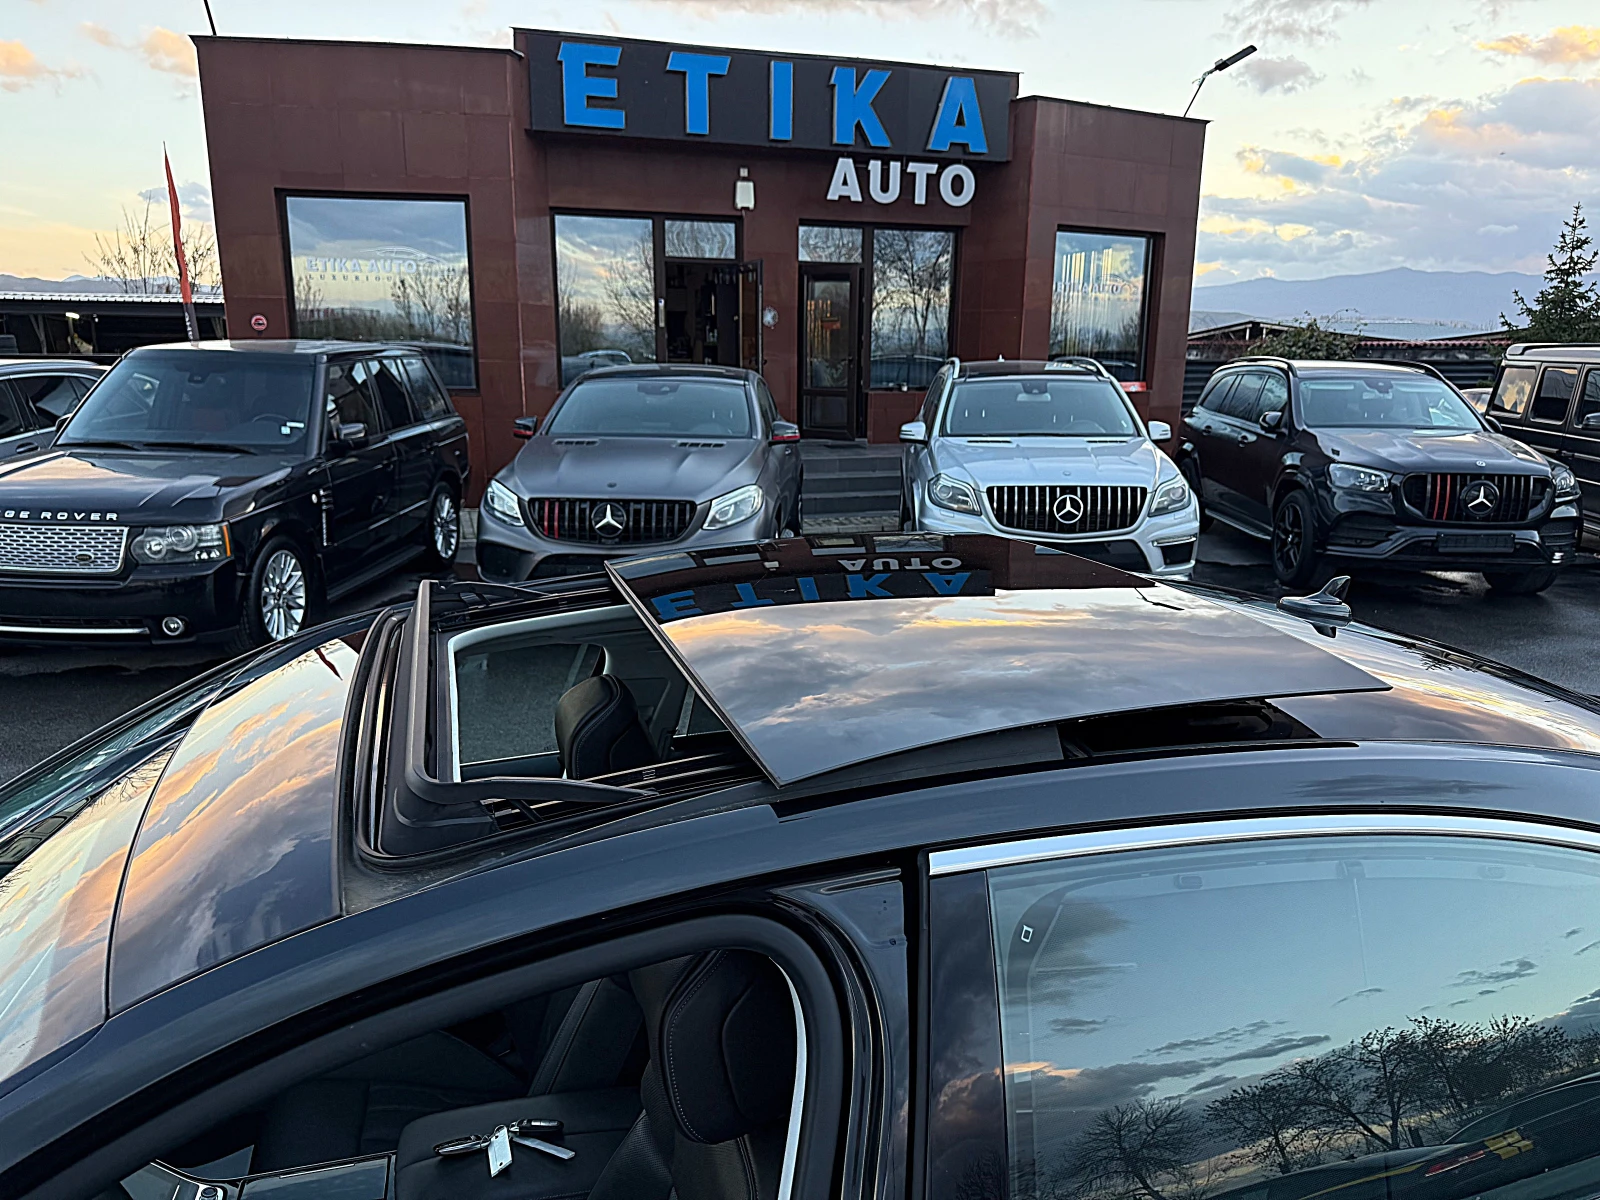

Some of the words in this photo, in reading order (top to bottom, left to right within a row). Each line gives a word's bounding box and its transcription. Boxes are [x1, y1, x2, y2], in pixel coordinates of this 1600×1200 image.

[557, 41, 989, 154] ETIKA
[826, 157, 976, 207] AUTO
[306, 257, 363, 273] ETIKA
[367, 258, 418, 275] AUTO
[308, 274, 393, 282] LUXURIOU
[0, 510, 30, 519] GE
[40, 511, 118, 521] ROVER
